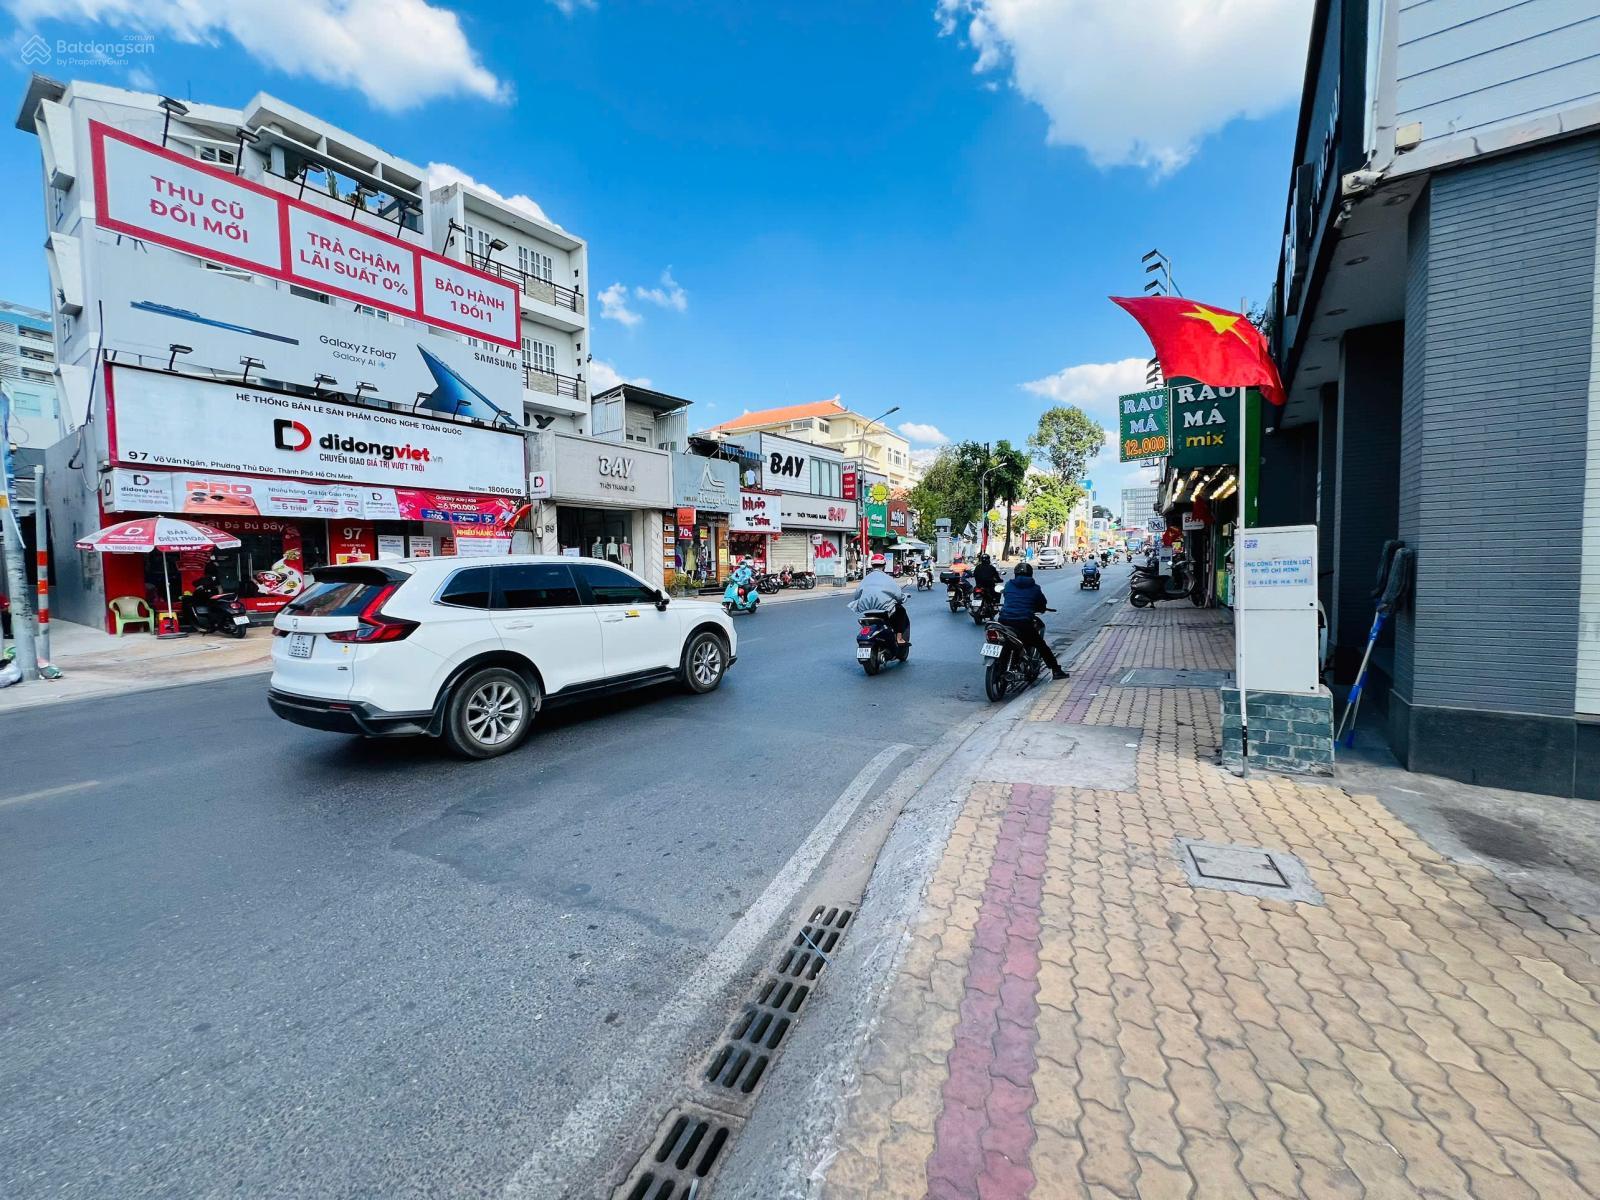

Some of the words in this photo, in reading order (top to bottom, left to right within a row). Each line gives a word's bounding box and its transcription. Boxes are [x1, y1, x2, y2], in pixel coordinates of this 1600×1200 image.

[150, 175, 204, 206] THU
[211, 198, 244, 220] CŨ
[149, 198, 196, 227] ĐỔI
[203, 216, 248, 243] MỚI
[307, 231, 345, 256] TRẢ
[349, 247, 400, 275] CHẬM
[300, 248, 330, 270] LÃI
[334, 261, 379, 285] SUẤT
[383, 277, 408, 295] 0%
[435, 278, 465, 297] BẢO
[467, 288, 505, 311] HÀNH
[450, 300, 457, 311] 1
[486, 312, 492, 322] 1
[319, 335, 360, 353] Galaxy
[362, 345, 368, 354] Z
[370, 347, 397, 360] Fold7
[332, 350, 366, 366] Galaxy
[474, 352, 518, 371] SAMSUNG
[1124, 394, 1164, 414] RAU
[1177, 384, 1236, 404] RAU
[253, 395, 289, 408] THỐNG
[291, 401, 311, 412] BÁN
[373, 415, 397, 425] CÔNG
[422, 423, 441, 432] TOÀN
[442, 427, 463, 435] QUỐC
[1130, 413, 1159, 434] MÁ
[1183, 402, 1226, 428] MÁ
[1124, 436, 1166, 456] 12.000
[1185, 431, 1224, 447] mix
[128, 450, 149, 461] 97
[243, 463, 258, 471] Thủ
[278, 467, 299, 475] Thành
[349, 457, 365, 466] GIAO
[366, 458, 378, 467] GIÁ
[379, 460, 390, 470] TRỊ
[391, 460, 409, 471] VƯỢT
[598, 455, 634, 479] BAY
[769, 452, 805, 478] BAY
[185, 480, 252, 494] PRO
[488, 485, 522, 495] 18006018
[827, 506, 848, 523] BAY
[343, 527, 362, 540] 97
